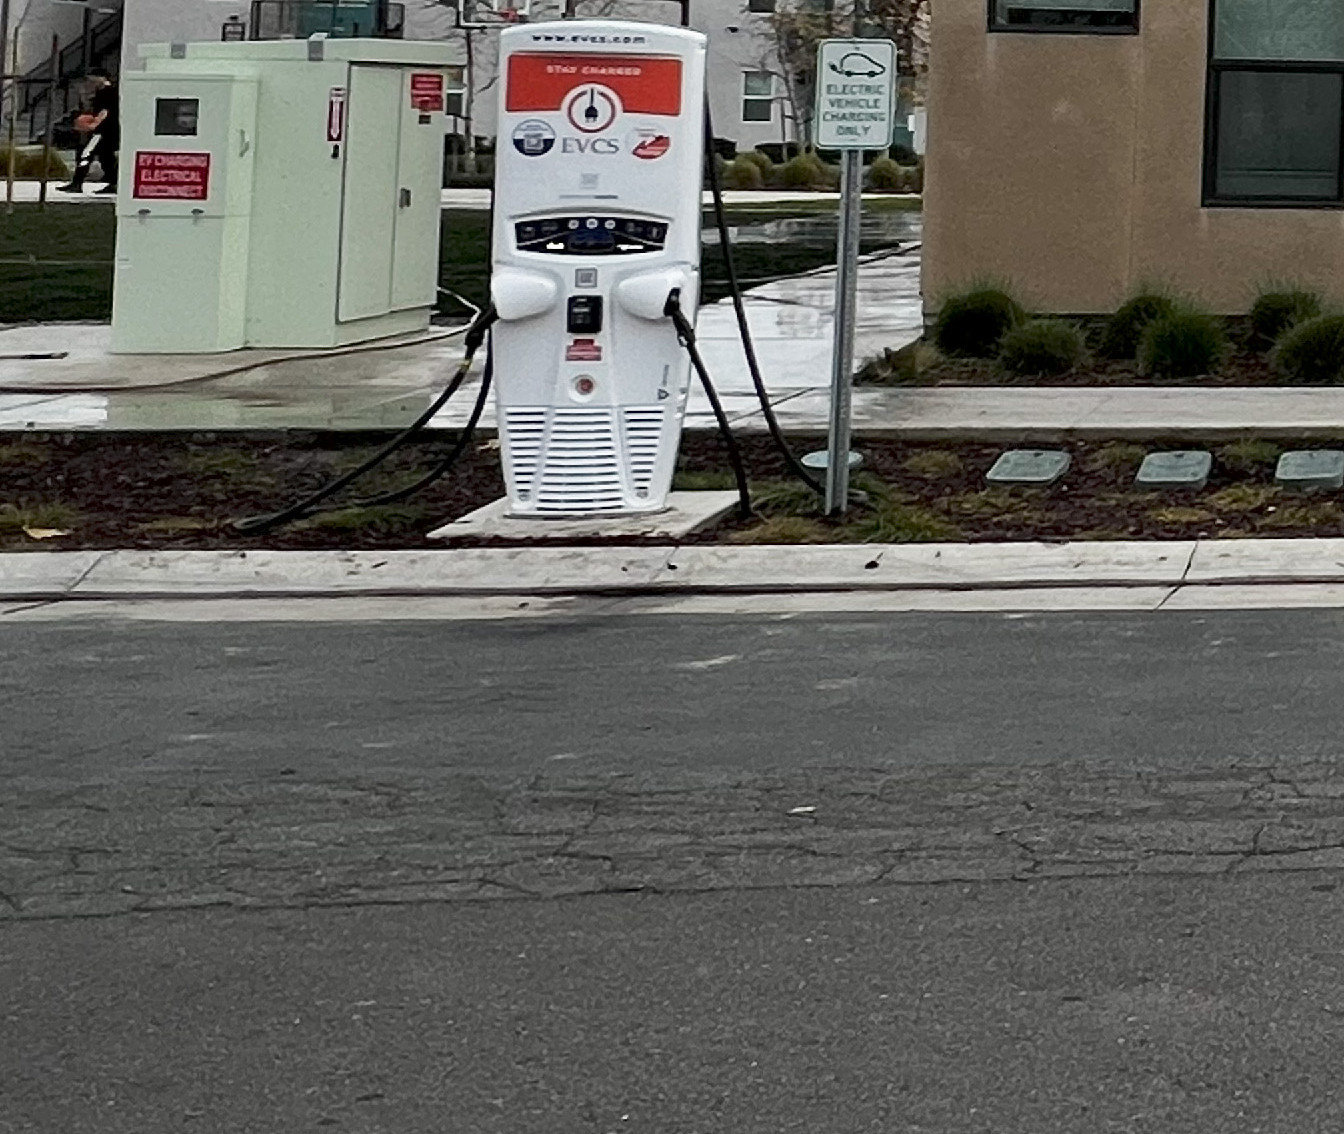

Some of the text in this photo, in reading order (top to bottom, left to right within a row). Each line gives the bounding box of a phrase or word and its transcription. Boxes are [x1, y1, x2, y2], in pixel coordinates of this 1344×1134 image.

[546, 64, 642, 76] STAY CHARGED
[826, 84, 885, 95] ELECTRIC
[828, 98, 881, 109] VEHICLE
[823, 111, 886, 122] CHARGING
[836, 125, 872, 137] ONLY
[561, 136, 620, 155] EVCS
[138, 154, 154, 167] EV
[140, 168, 203, 182] ELECTRICAL
